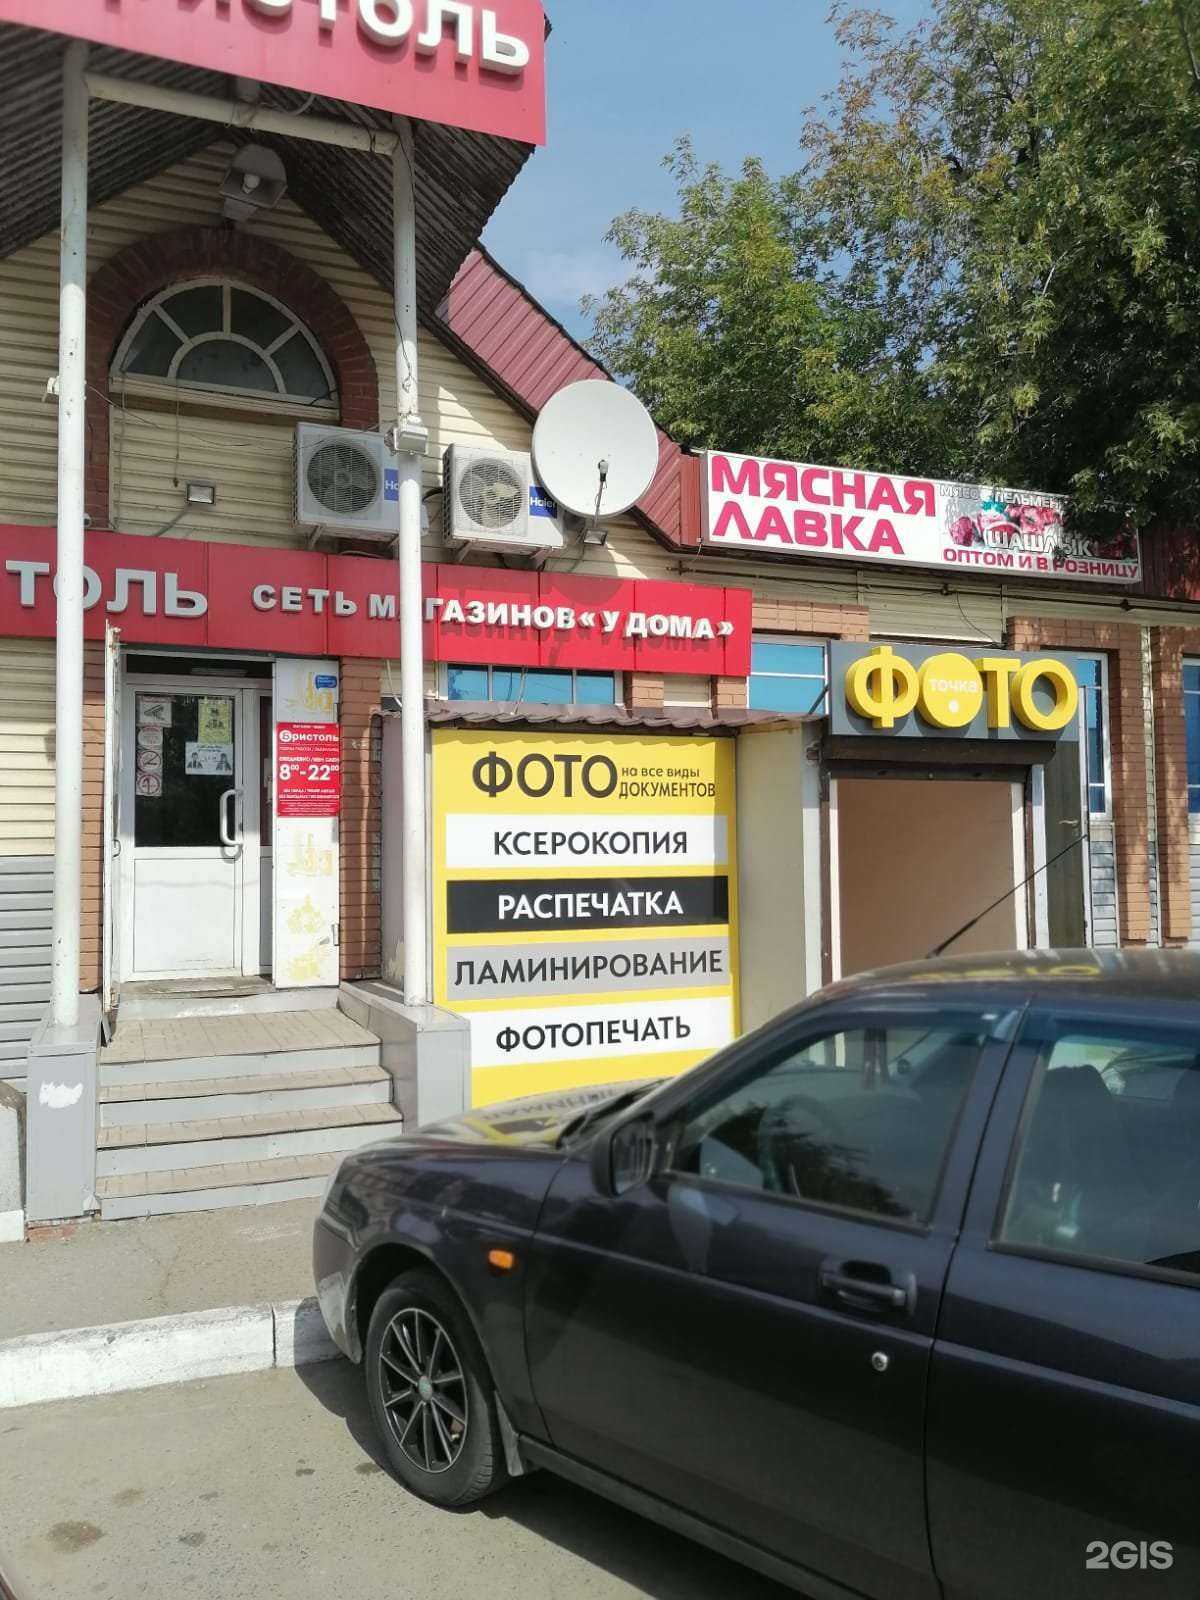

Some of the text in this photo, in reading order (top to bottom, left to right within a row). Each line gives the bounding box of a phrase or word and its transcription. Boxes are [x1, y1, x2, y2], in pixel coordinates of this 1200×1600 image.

[711, 455, 937, 517] МЯСНАЯ
[995, 490, 1068, 510] ПЕЛЬМЕН
[712, 500, 905, 555] ЛАВКА
[988, 528, 1093, 558] ШАШЛЫК
[943, 547, 1139, 579] ОПТОМ И В РОЗНИЦУ
[252, 584, 358, 616] СЕТЬ
[367, 593, 576, 630] МГАЗИНОВ
[845, 645, 1079, 731] ФОТО
[471, 751, 700, 798] ФОТО на все виды
[619, 781, 716, 800] ДОКУМЕНТОВ
[493, 831, 688, 856] КСЕРОКОПИЯ
[498, 890, 683, 920] РАСПЕЧАТКА
[454, 949, 723, 987] ЛАМИНИРОВАНИЕ
[496, 1015, 691, 1052] ФОТОПЕЧАТЬ
